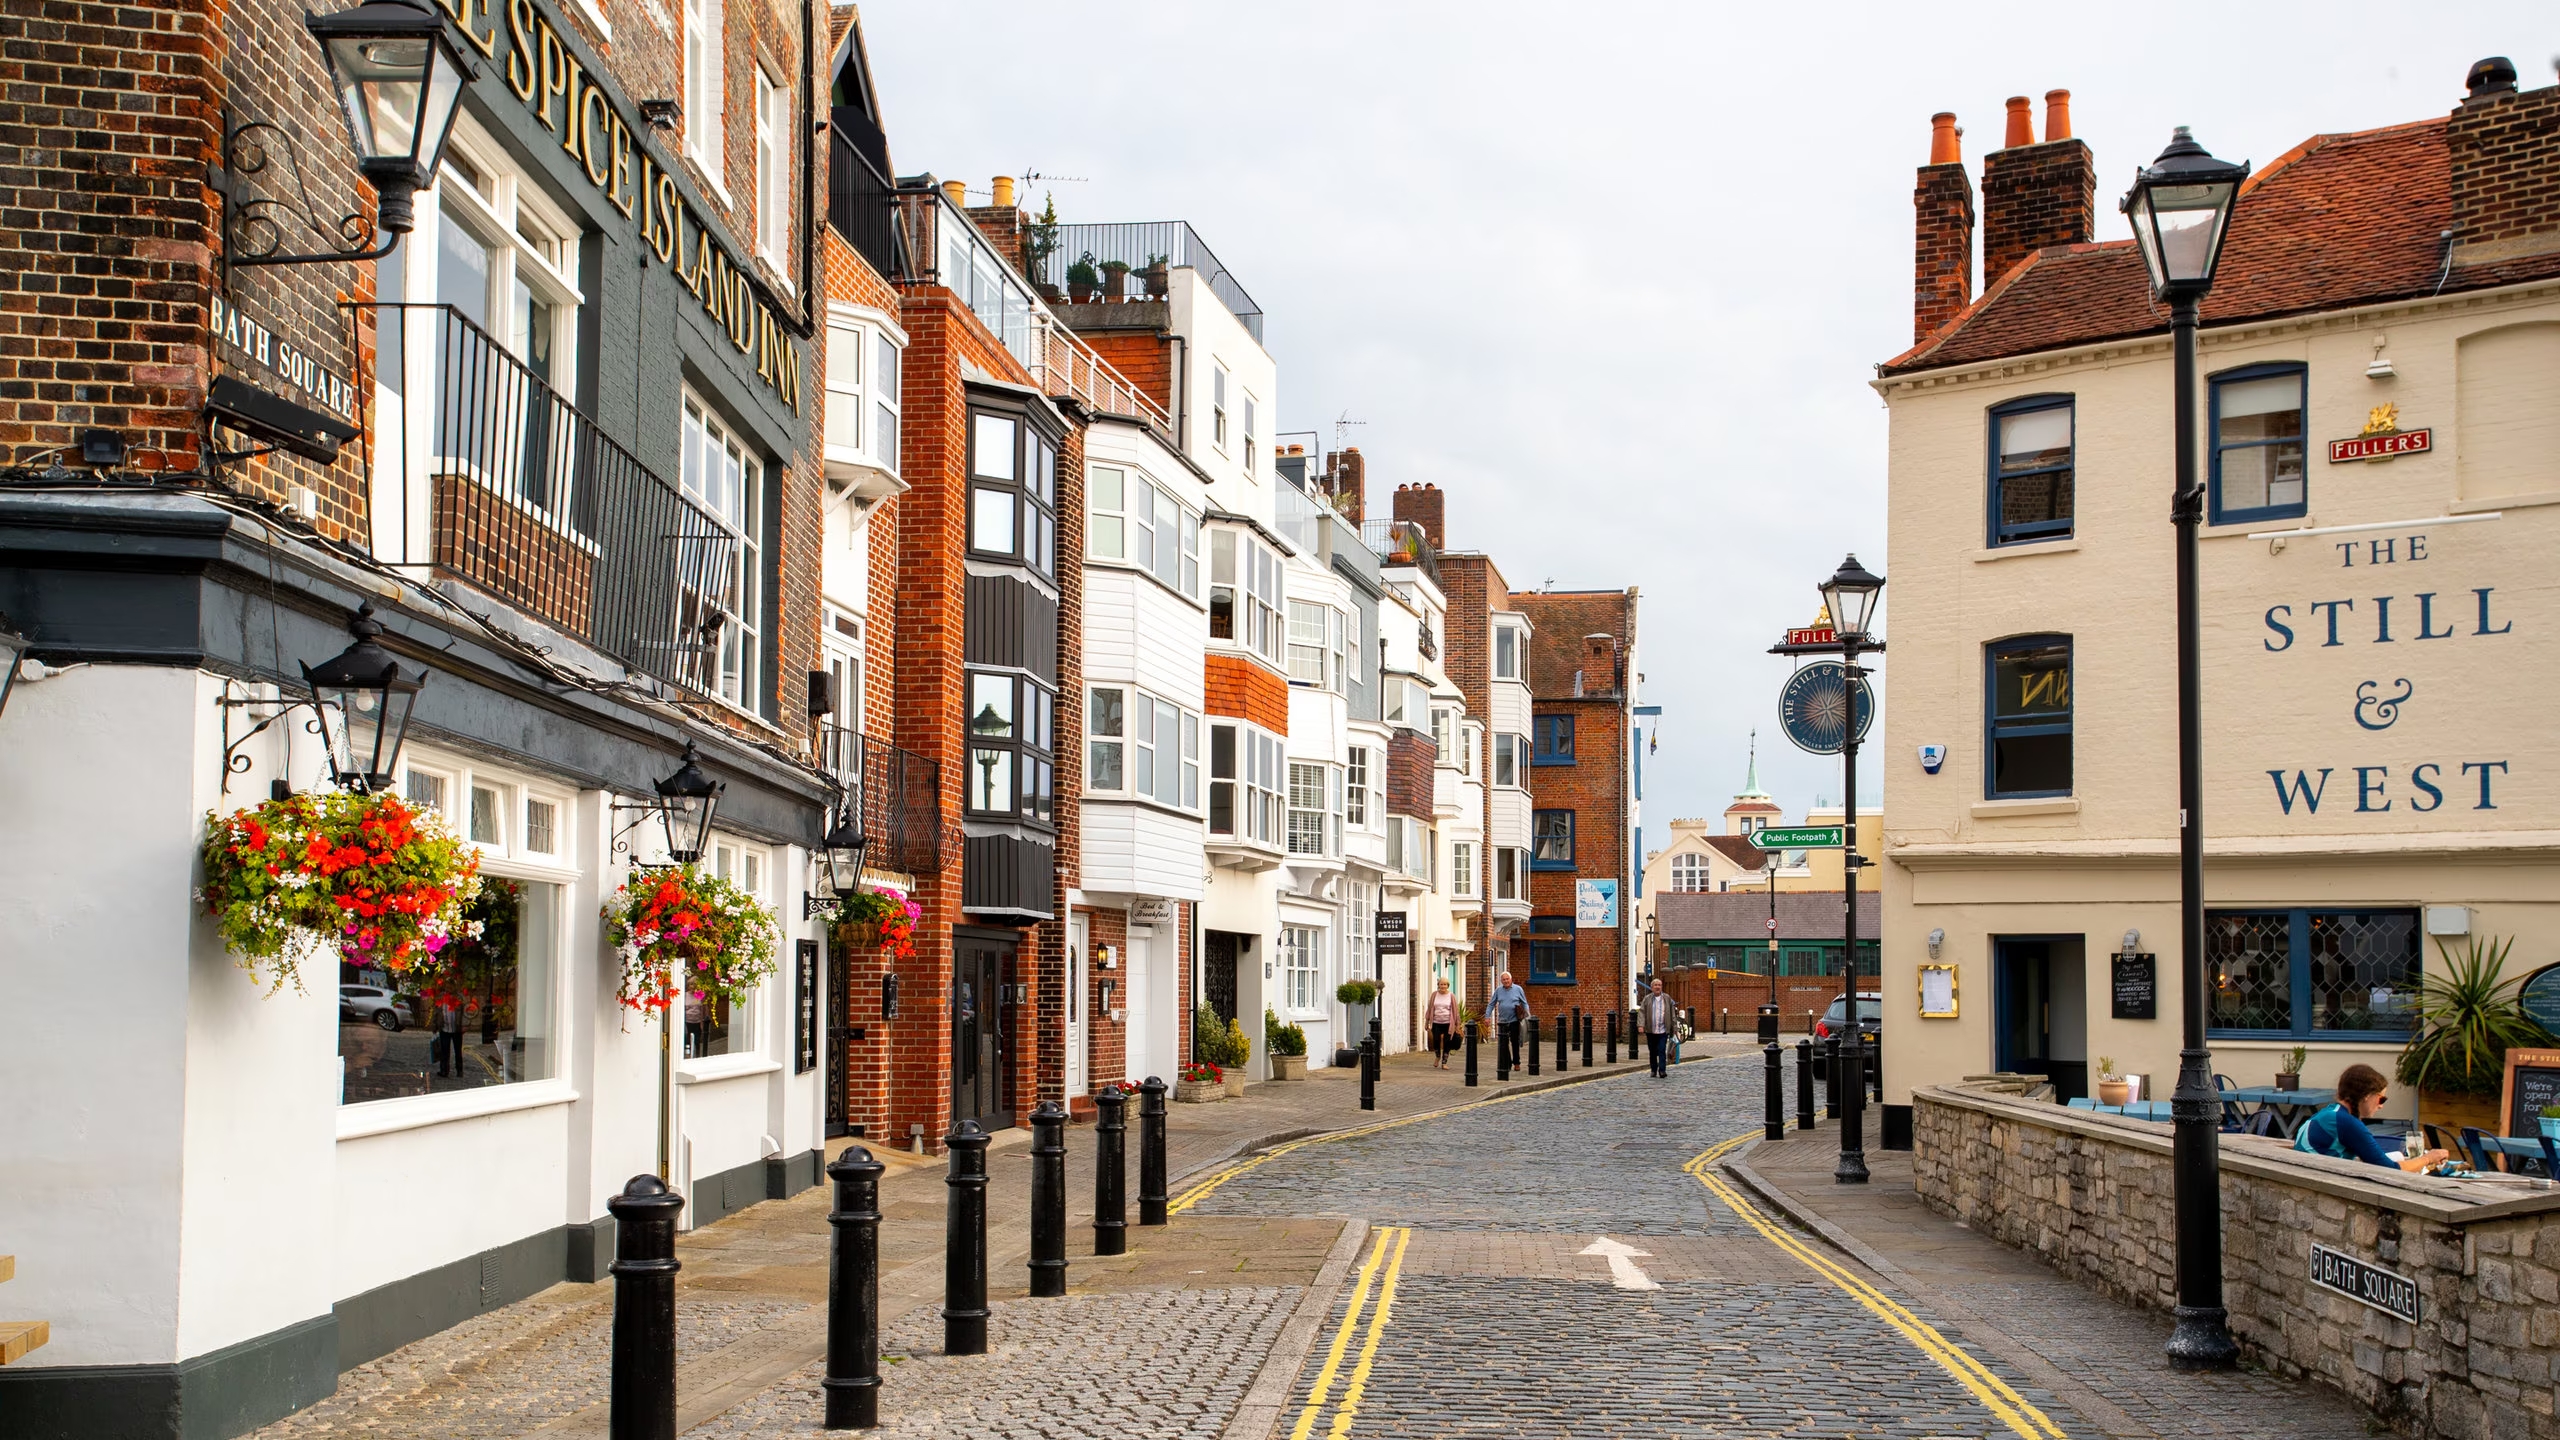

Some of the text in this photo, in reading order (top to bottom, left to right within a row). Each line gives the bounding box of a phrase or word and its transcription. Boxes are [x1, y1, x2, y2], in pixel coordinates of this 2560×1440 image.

[506, 0, 800, 419] SPICE ISLAND INN
[210, 295, 353, 420] BATH SQUARE
[2335, 434, 2423, 458] FULLER'S
[2336, 535, 2429, 568] THE
[2263, 587, 2513, 653] STILL
[1792, 631, 1838, 643] FULLE
[1789, 669, 1819, 696] STILL
[1822, 666, 1833, 676] &
[1784, 699, 1796, 726] THE
[2354, 677, 2414, 731] &
[2265, 760, 2509, 816] WEST
[1766, 833, 1827, 843] Public Footpath
[1134, 910, 1170, 919] Breakfast
[1578, 911, 1597, 921] Club
[2524, 1091, 2552, 1101] open
[2525, 1081, 2553, 1091] We're
[2522, 1101, 2542, 1113] for
[2324, 1255, 2414, 1316] BATH SQUARE
